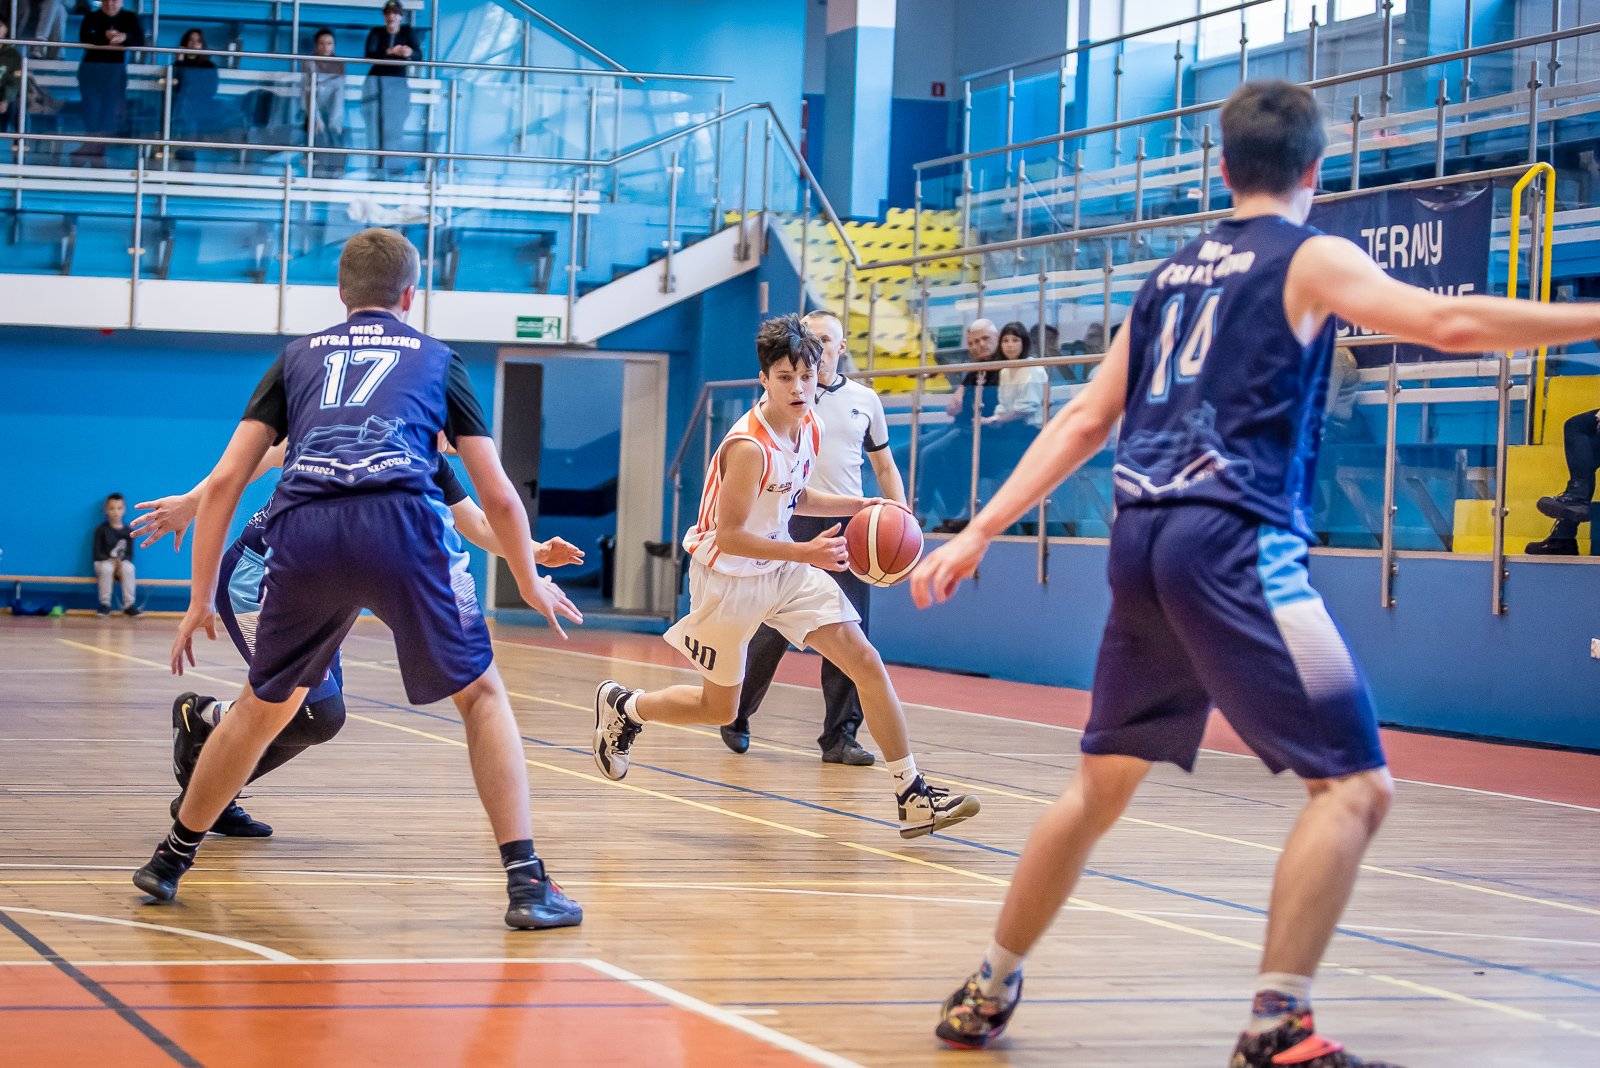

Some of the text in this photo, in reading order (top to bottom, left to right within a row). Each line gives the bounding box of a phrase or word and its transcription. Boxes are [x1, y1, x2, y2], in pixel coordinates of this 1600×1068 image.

[1361, 219, 1443, 269] TERMY
[310, 334, 421, 350] NYSA KŁODZKO
[1146, 287, 1224, 402] 14
[320, 348, 401, 410] 17
[685, 635, 717, 671] 40
